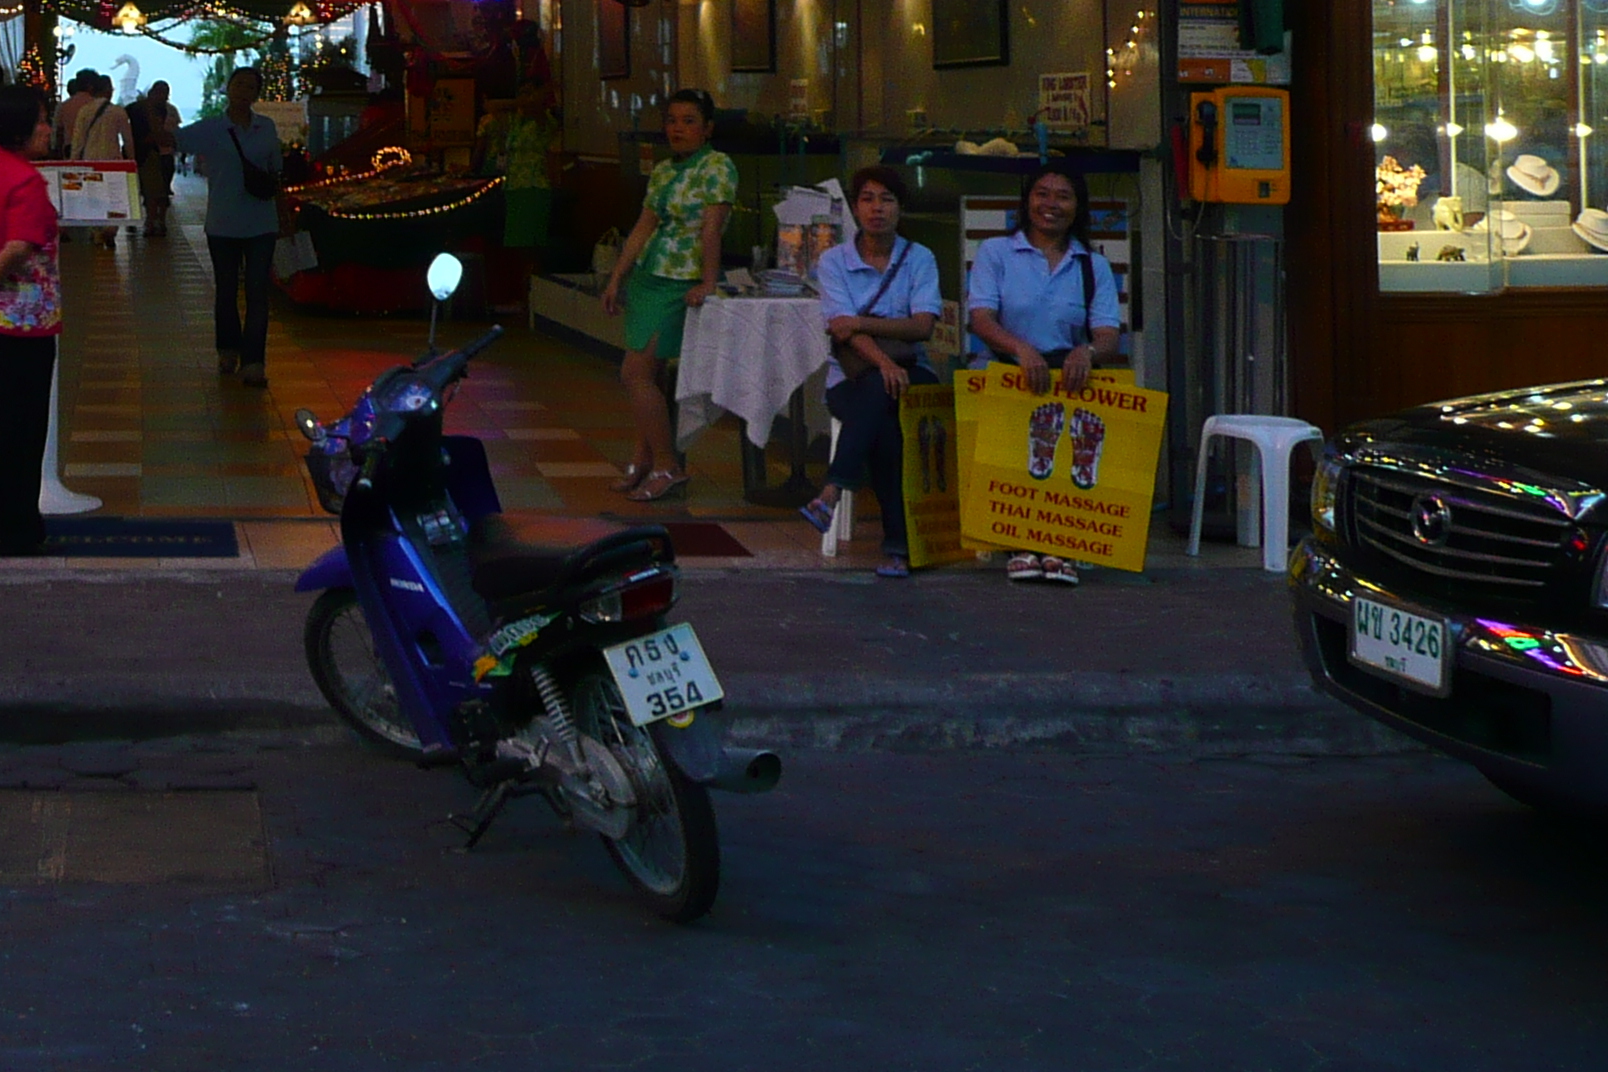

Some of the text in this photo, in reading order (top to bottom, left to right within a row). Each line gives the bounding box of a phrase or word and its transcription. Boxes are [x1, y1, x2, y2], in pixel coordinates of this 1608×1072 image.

[988, 480, 1131, 519] FOOT MASSAGE
[989, 500, 1123, 538] THAI MASSAGE
[991, 521, 1113, 557] OIL MASSAGE
[1389, 612, 1439, 659] 3426
[646, 680, 703, 717] 354
